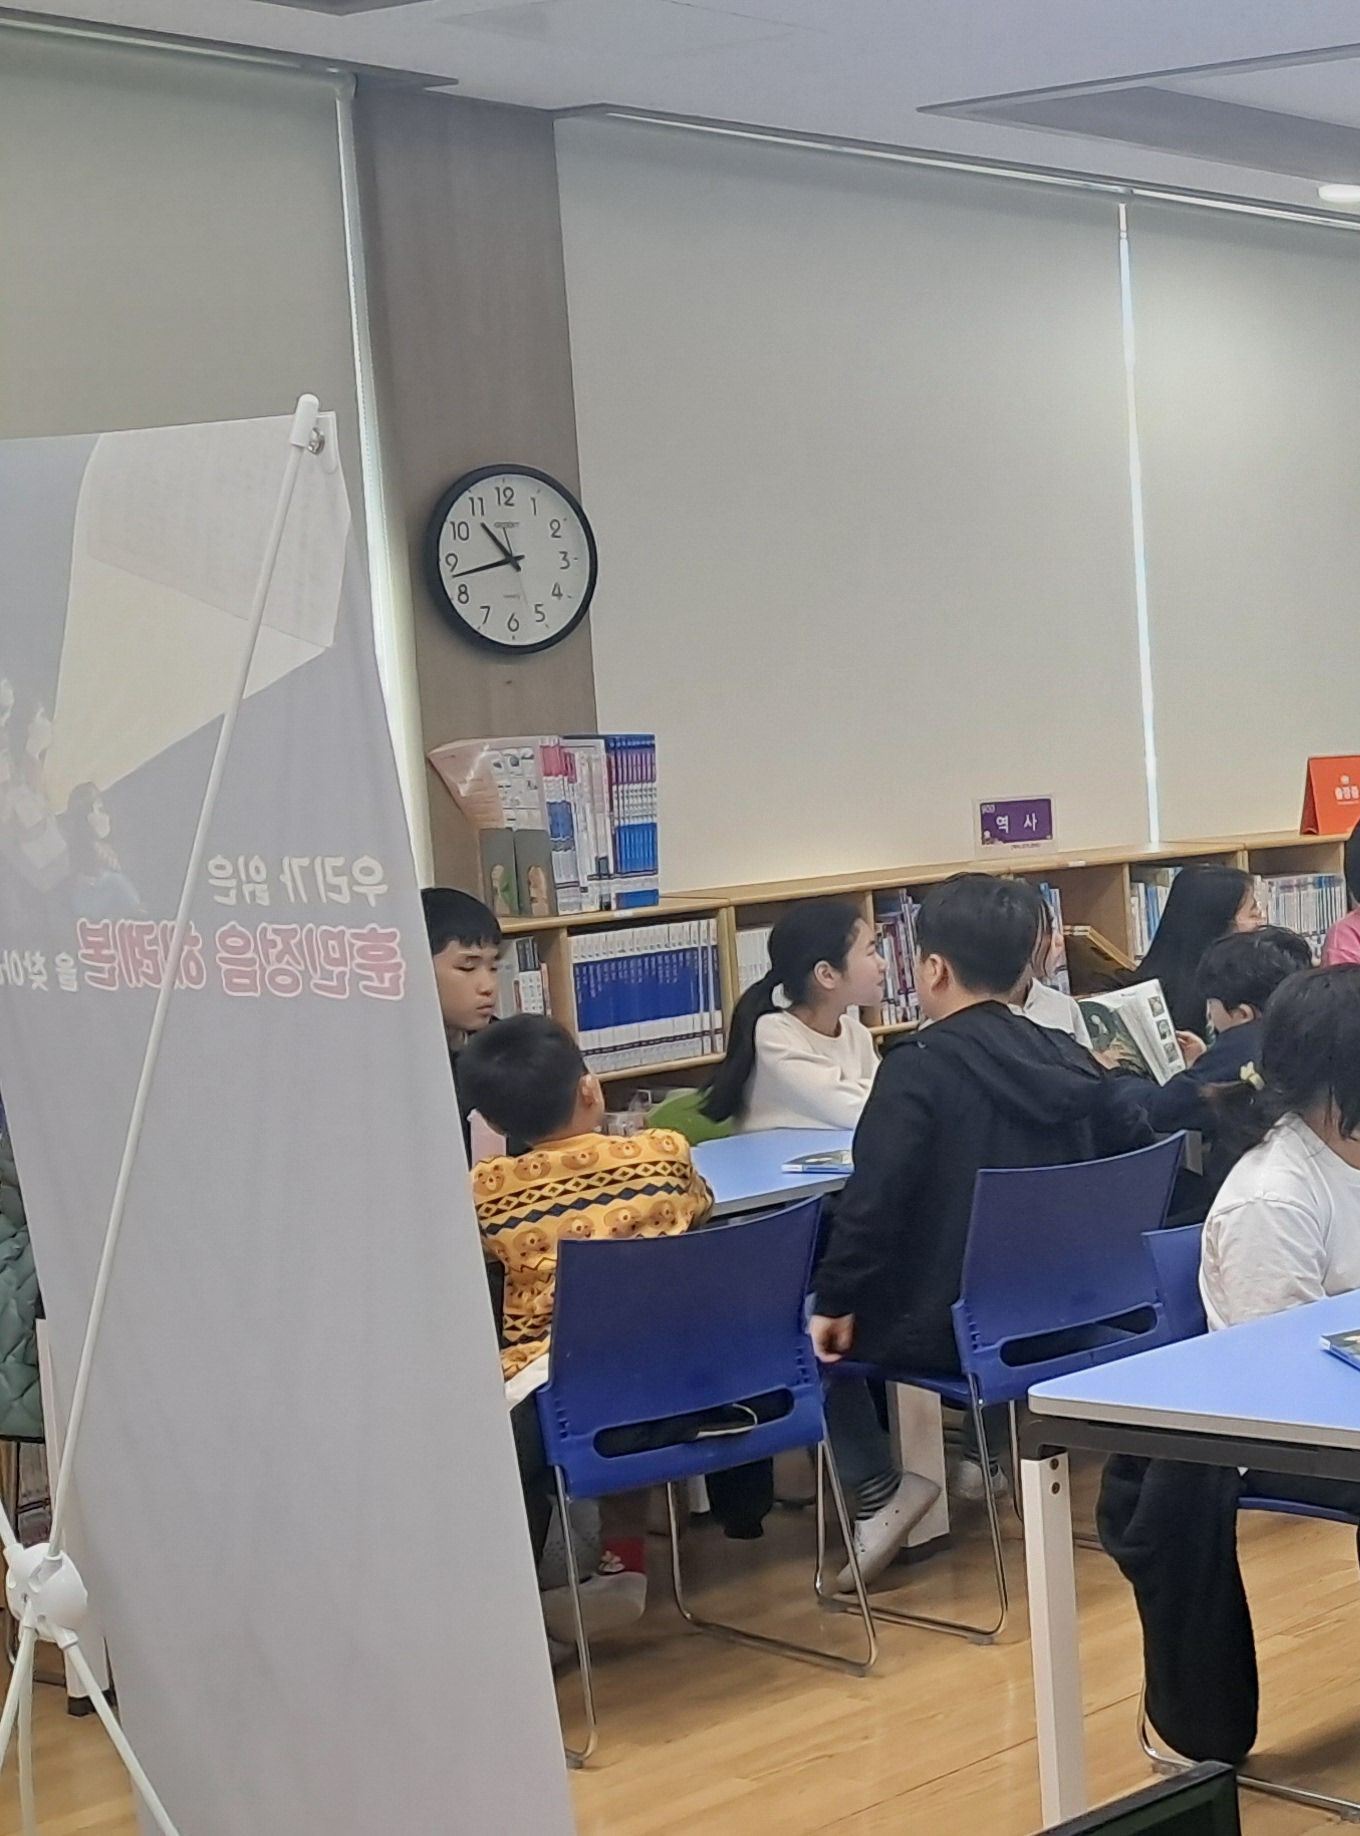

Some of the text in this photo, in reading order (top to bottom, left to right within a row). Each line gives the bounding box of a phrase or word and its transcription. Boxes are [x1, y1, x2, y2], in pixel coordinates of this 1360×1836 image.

[495, 487, 515, 506] 12
[469, 497, 485, 516] 11
[531, 497, 537, 516] 1
[450, 521, 470, 541] 10
[550, 519, 562, 538] 2
[445, 553, 458, 572] 9
[559, 551, 571, 569] 3
[457, 584, 469, 604] 8
[551, 582, 563, 601] 4
[480, 605, 491, 624] 7
[507, 613, 519, 632] 6
[534, 604, 546, 622] 5
